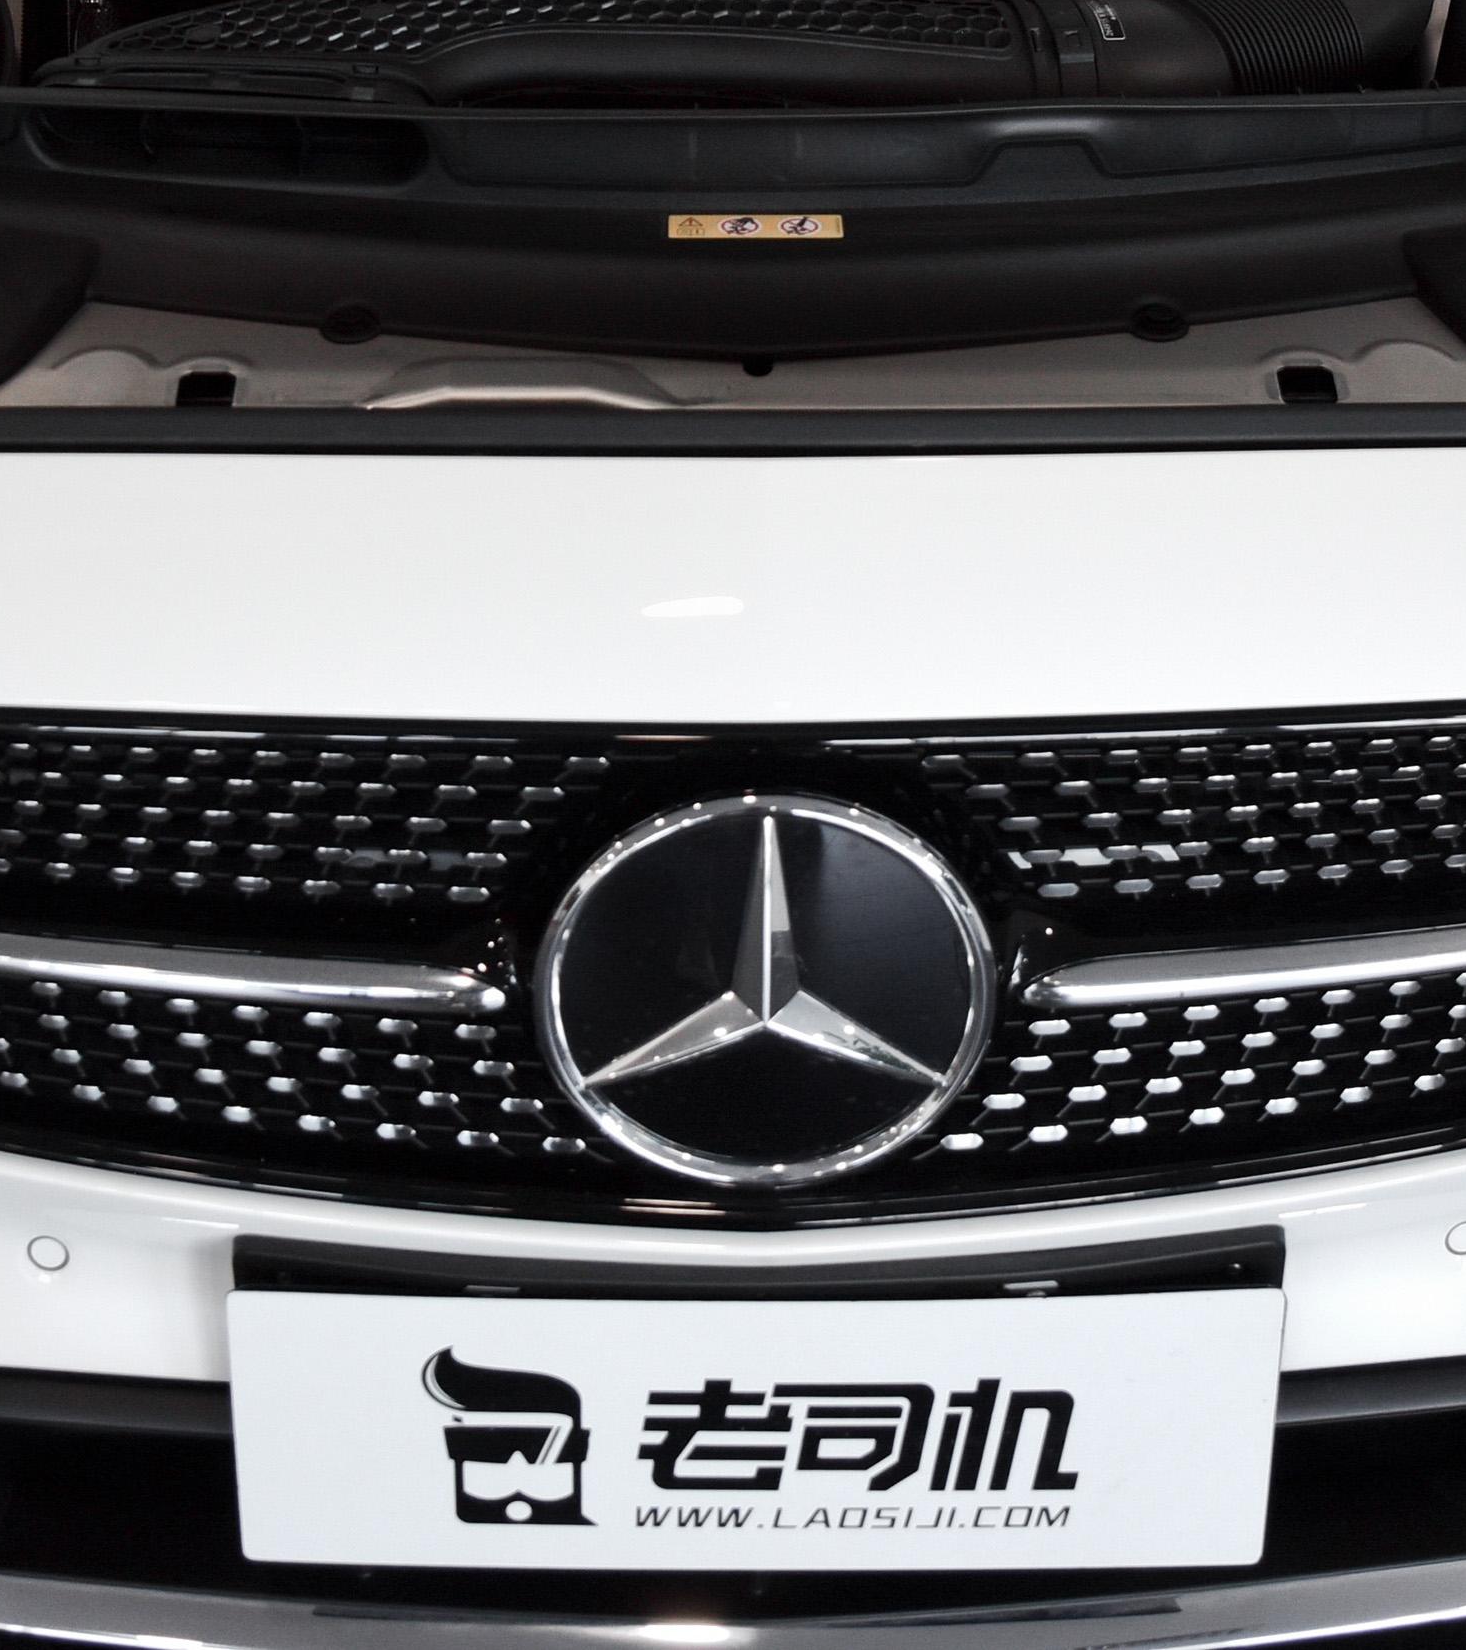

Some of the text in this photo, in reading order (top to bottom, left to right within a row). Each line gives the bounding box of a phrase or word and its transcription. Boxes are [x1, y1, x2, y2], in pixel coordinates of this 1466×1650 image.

[636, 1378, 1079, 1492] 老司机
[634, 1504, 1073, 1530] WWW.LAOSIJI.COM
